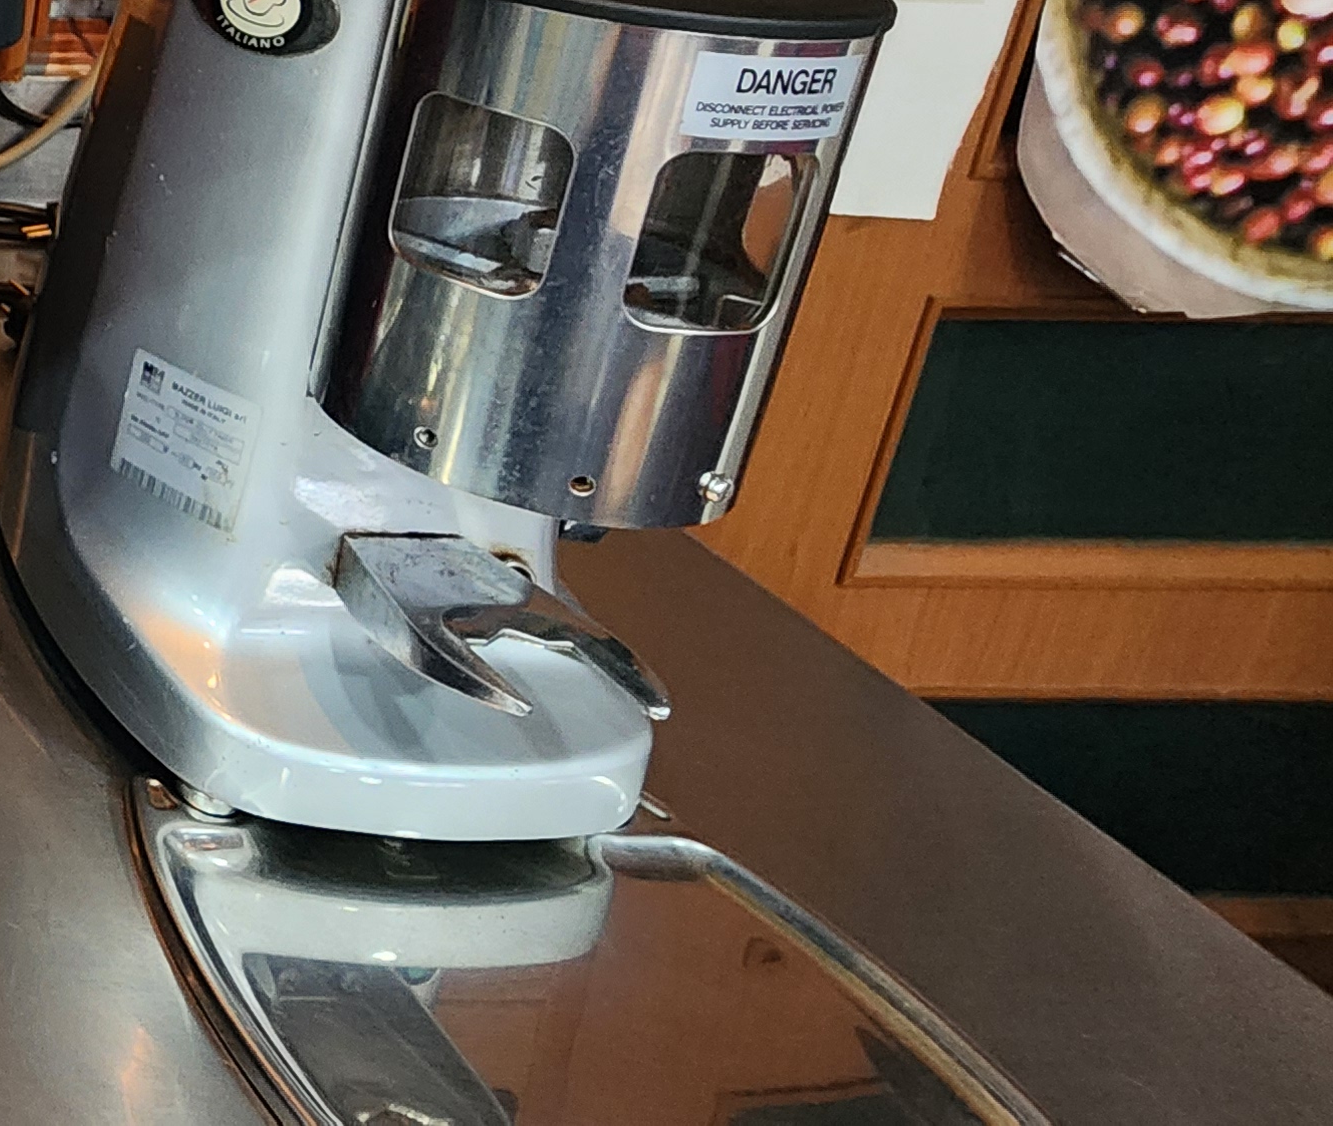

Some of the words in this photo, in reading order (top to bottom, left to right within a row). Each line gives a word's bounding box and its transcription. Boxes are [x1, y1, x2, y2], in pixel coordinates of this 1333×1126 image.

[216, 14, 286, 49] ITALIANO
[735, 68, 838, 95] DANGER
[695, 101, 766, 116] DISCONNECT
[768, 103, 820, 116] ELECTRICAL
[710, 117, 750, 129] SUPPLY
[752, 119, 788, 130] BEFORE
